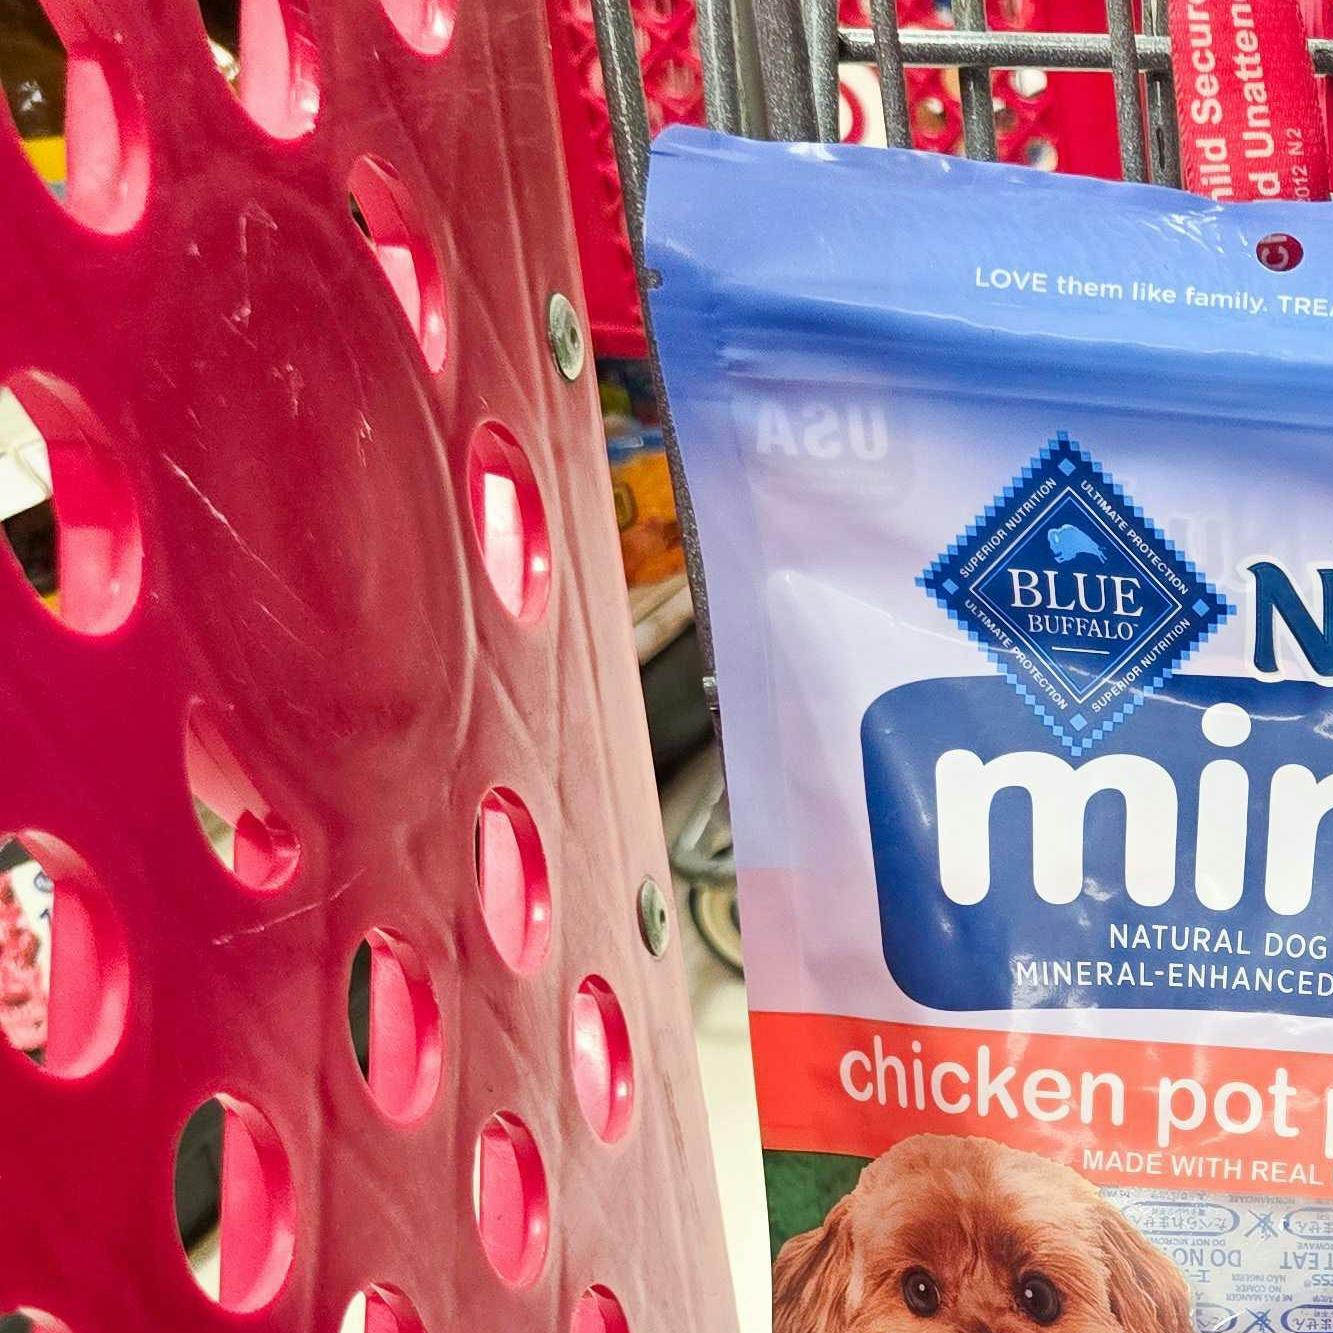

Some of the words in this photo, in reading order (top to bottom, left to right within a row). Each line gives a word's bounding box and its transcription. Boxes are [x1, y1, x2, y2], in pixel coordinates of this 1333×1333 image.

[1229, 0, 1275, 159] Unatten
[975, 266, 1048, 294] LOVE
[1055, 274, 1124, 300] them
[1131, 281, 1177, 305] like
[1185, 286, 1269, 316] family.
[959, 529, 1008, 578] SUPERIOR
[1005, 477, 1057, 532] NUTRITION
[1080, 479, 1128, 532] ULTIMATE
[1126, 529, 1190, 595] PROTECTION
[1007, 568, 1143, 617] BLUE
[964, 600, 1013, 650] ULTIMATE
[1011, 646, 1068, 710] PROTECTION
[1091, 664, 1144, 713] SUPERIOR
[1139, 618, 1191, 669] NUTRITION
[1110, 923, 1252, 956] NATURAL
[1264, 930, 1328, 961] DOG
[839, 1035, 1126, 1127] chicken
[1157, 1067, 1303, 1147] pot
[1083, 1149, 1165, 1178] MADE
[1171, 1153, 1242, 1182] WITH
[1251, 1159, 1324, 1187] REAL
[1211, 1249, 1240, 1268] DO
[1279, 1251, 1318, 1269] EAT
